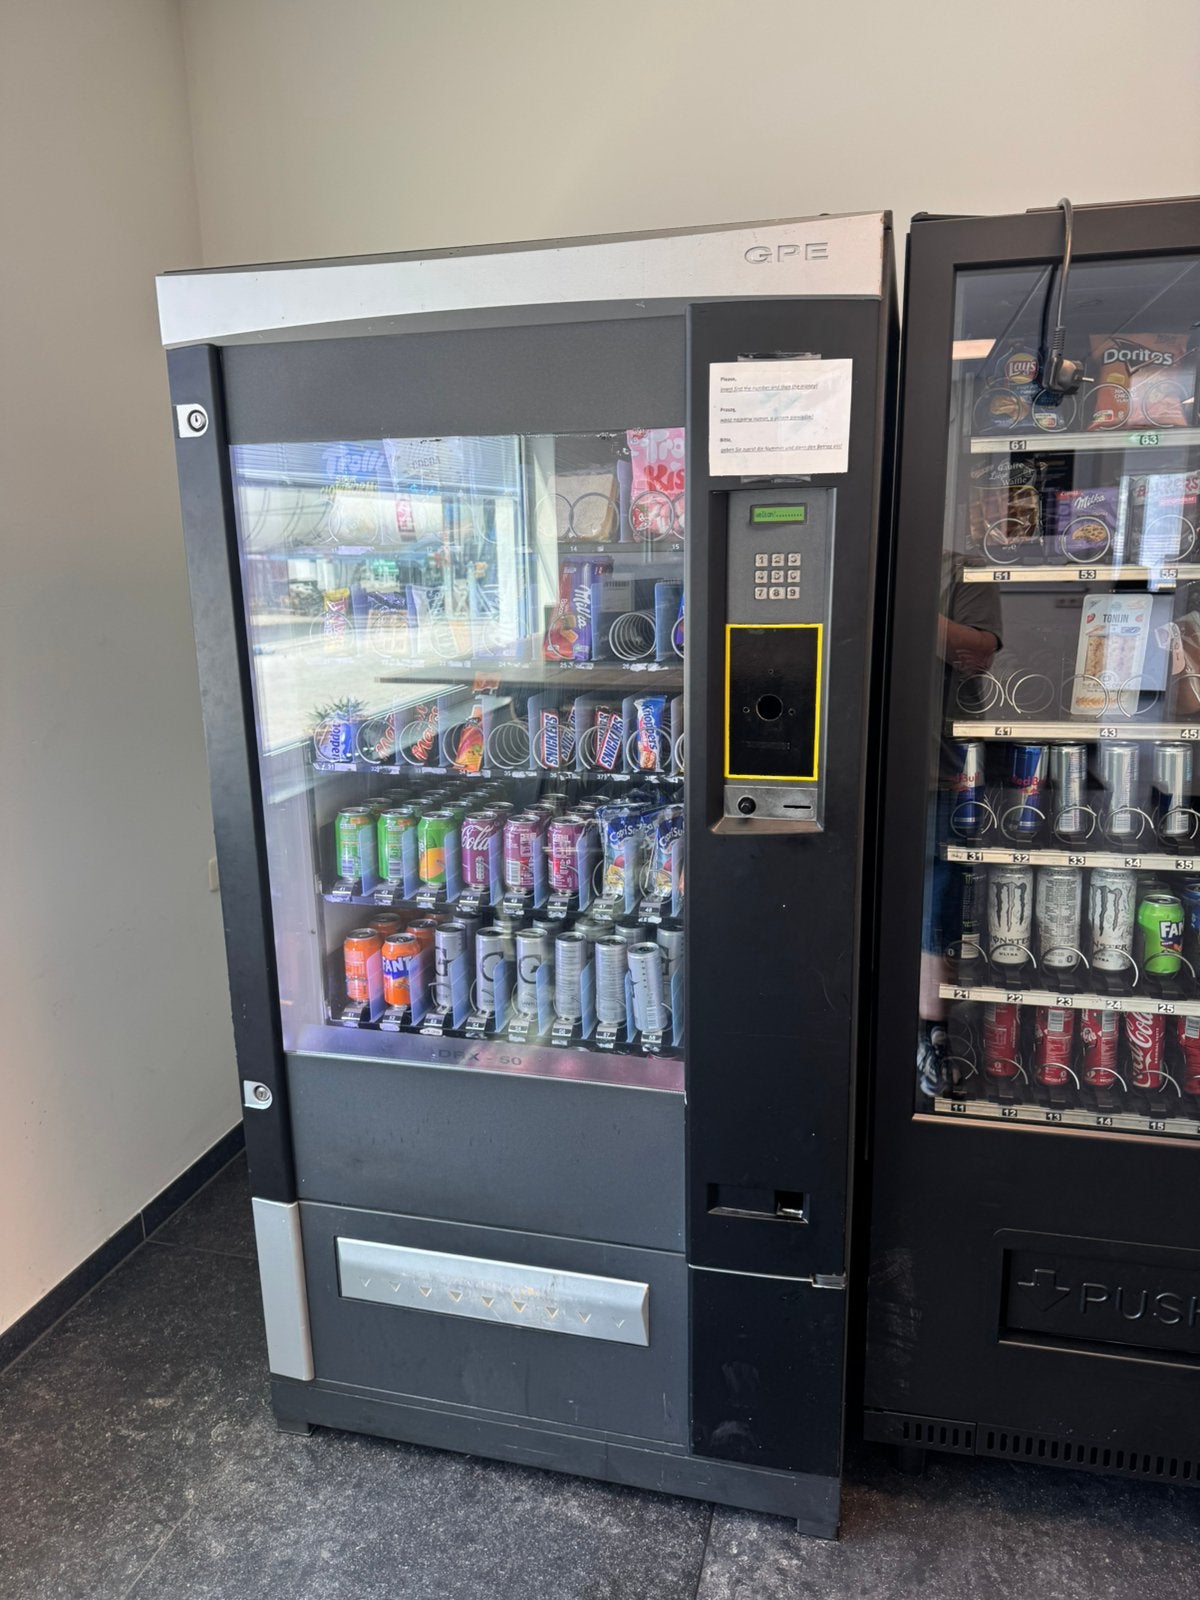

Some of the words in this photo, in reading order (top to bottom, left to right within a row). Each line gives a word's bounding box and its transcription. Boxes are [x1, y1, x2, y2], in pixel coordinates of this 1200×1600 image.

[744, 242, 829, 265] GPE
[1103, 348, 1173, 365] Doritos
[1010, 441, 1026, 450] 61
[1141, 435, 1158, 445] 63
[1073, 494, 1106, 510] Milka
[672, 543, 680, 551] 15
[759, 555, 764, 564] 1
[774, 555, 781, 564] 2
[994, 571, 1009, 580] 51
[1080, 570, 1096, 579] 53
[1161, 569, 1177, 579] 55
[757, 588, 764, 597] 7
[773, 588, 780, 597] 8
[789, 588, 796, 597] 9
[643, 704, 658, 751] Knoppers
[996, 727, 1011, 736] 41
[1101, 728, 1116, 738] 43
[1181, 729, 1198, 739] 45
[546, 714, 558, 767] SNICKERS
[971, 852, 983, 860] 31
[1013, 854, 1030, 863] 32
[1068, 857, 1085, 865] 33
[1125, 859, 1141, 867] 34
[1177, 860, 1193, 869] 35
[954, 990, 970, 998] 21
[1007, 993, 1023, 1002] 22
[1057, 997, 1073, 1007] 23
[1107, 1000, 1122, 1009] 24
[1159, 1004, 1175, 1013] 25
[952, 1104, 966, 1112] 11
[1003, 1109, 1017, 1117] 12
[1098, 1117, 1113, 1126] 14
[1150, 1122, 1164, 1131] 15
